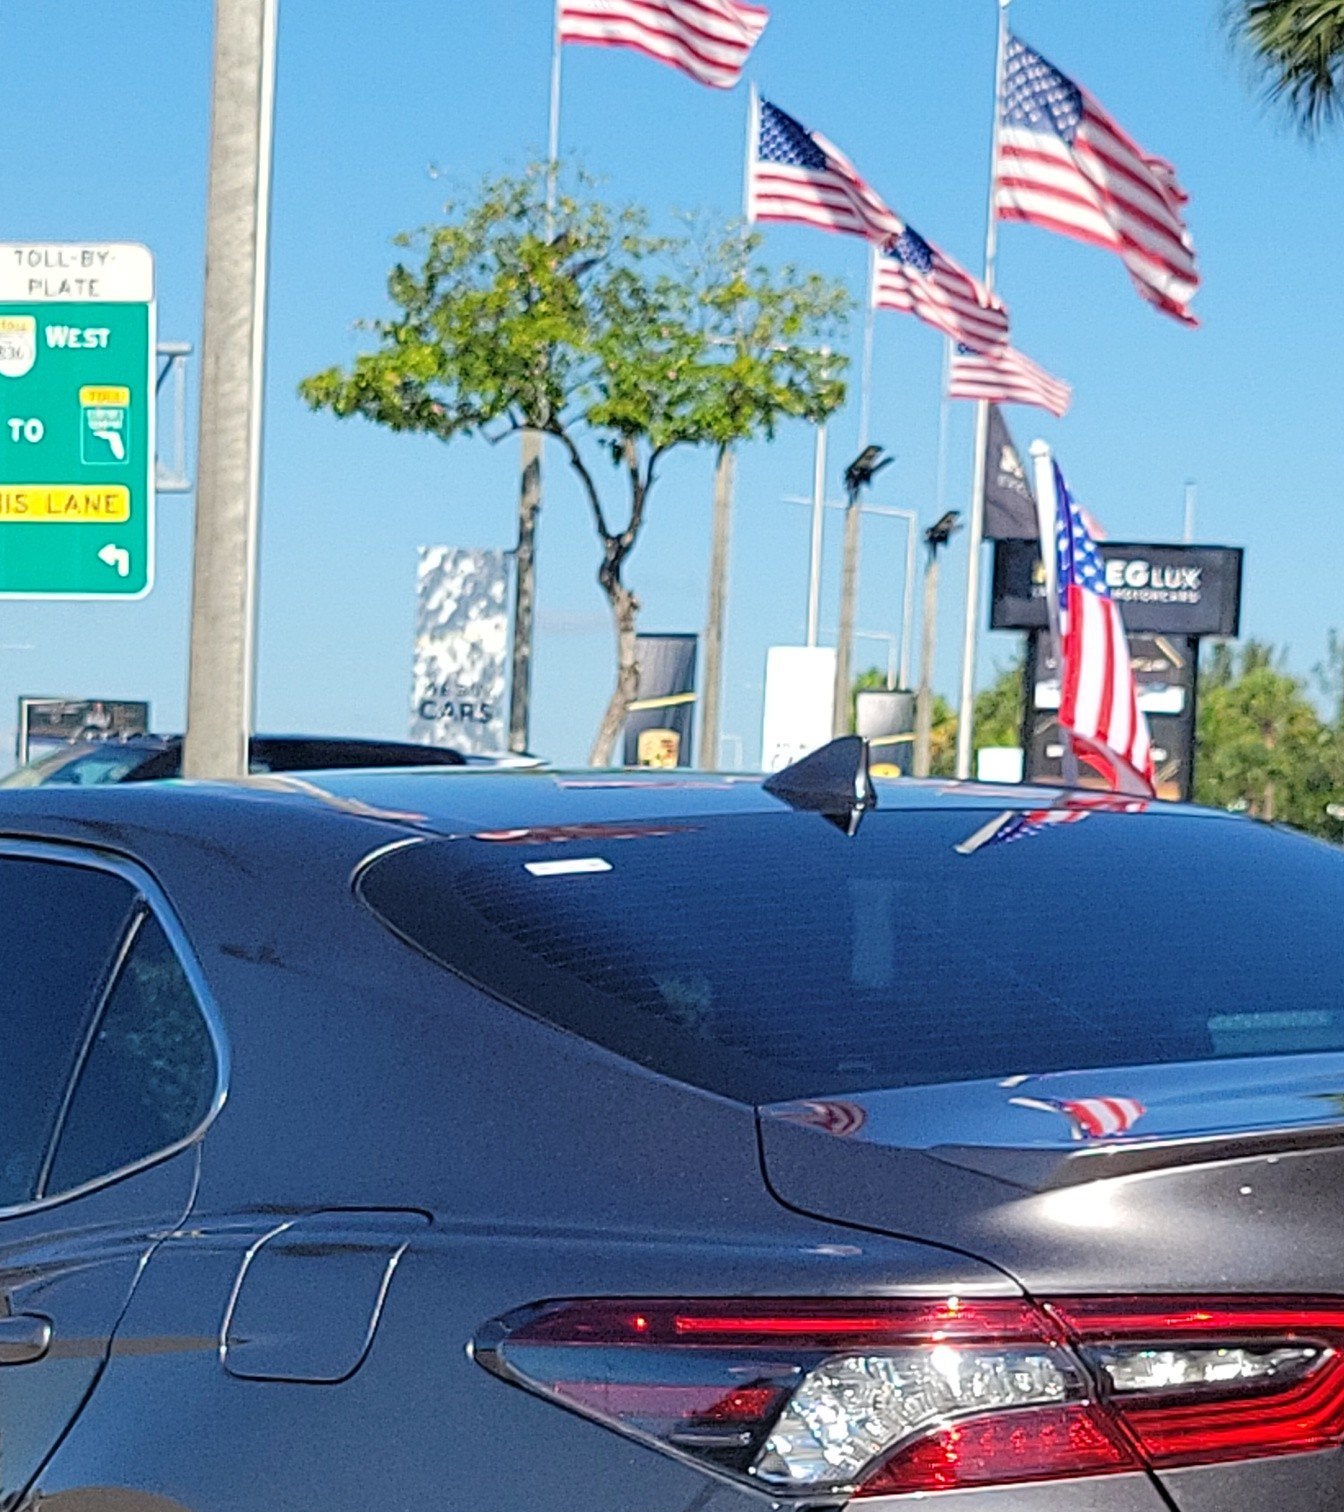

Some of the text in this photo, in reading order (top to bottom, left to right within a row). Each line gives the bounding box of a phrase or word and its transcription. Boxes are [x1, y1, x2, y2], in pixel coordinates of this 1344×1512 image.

[28, 278, 100, 298] PLATE
[44, 325, 111, 349] WEST
[7, 417, 45, 444] TO
[46, 493, 120, 515] LANE
[1151, 566, 1202, 590] LUX
